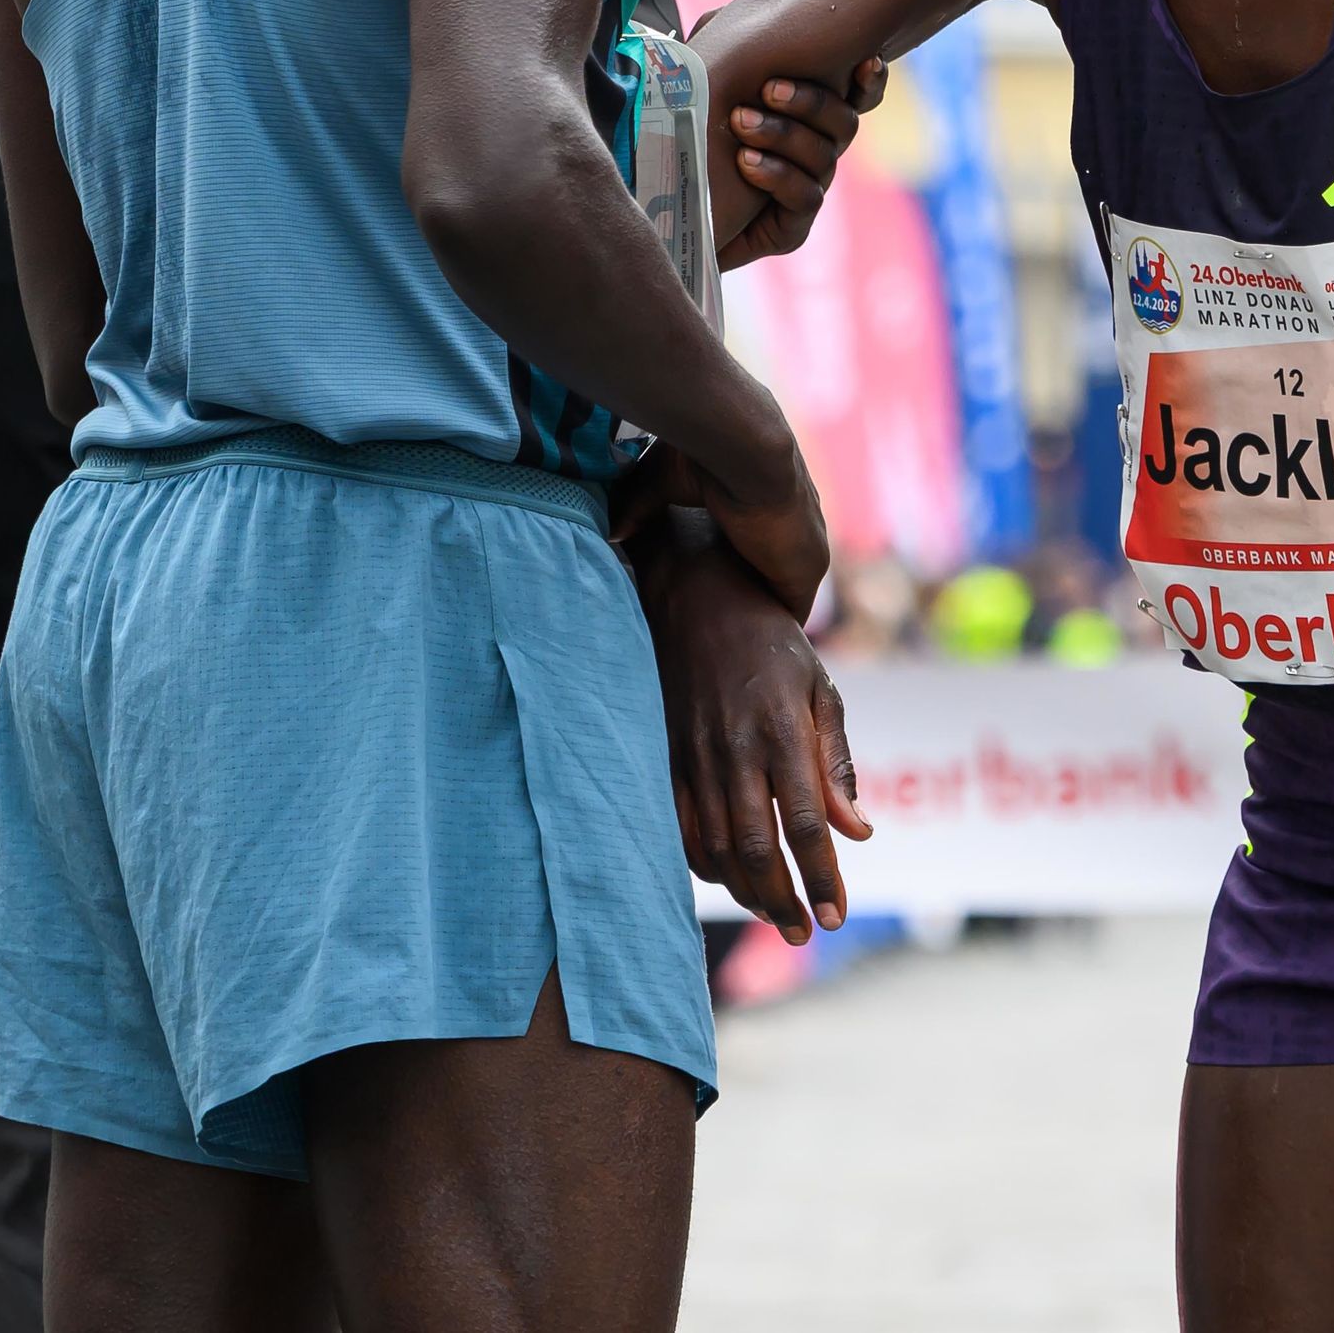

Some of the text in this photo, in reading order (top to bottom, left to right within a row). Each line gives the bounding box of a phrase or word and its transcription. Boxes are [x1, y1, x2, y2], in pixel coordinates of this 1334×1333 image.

[1190, 264, 1307, 295] 24.Oberbank
[1132, 293, 1178, 313] 12.4.2026
[1193, 288, 1315, 313] LINZ DONAU
[1197, 310, 1320, 334] MARATHON
[1273, 368, 1305, 397] 12
[1201, 547, 1302, 567] OBERBANK
